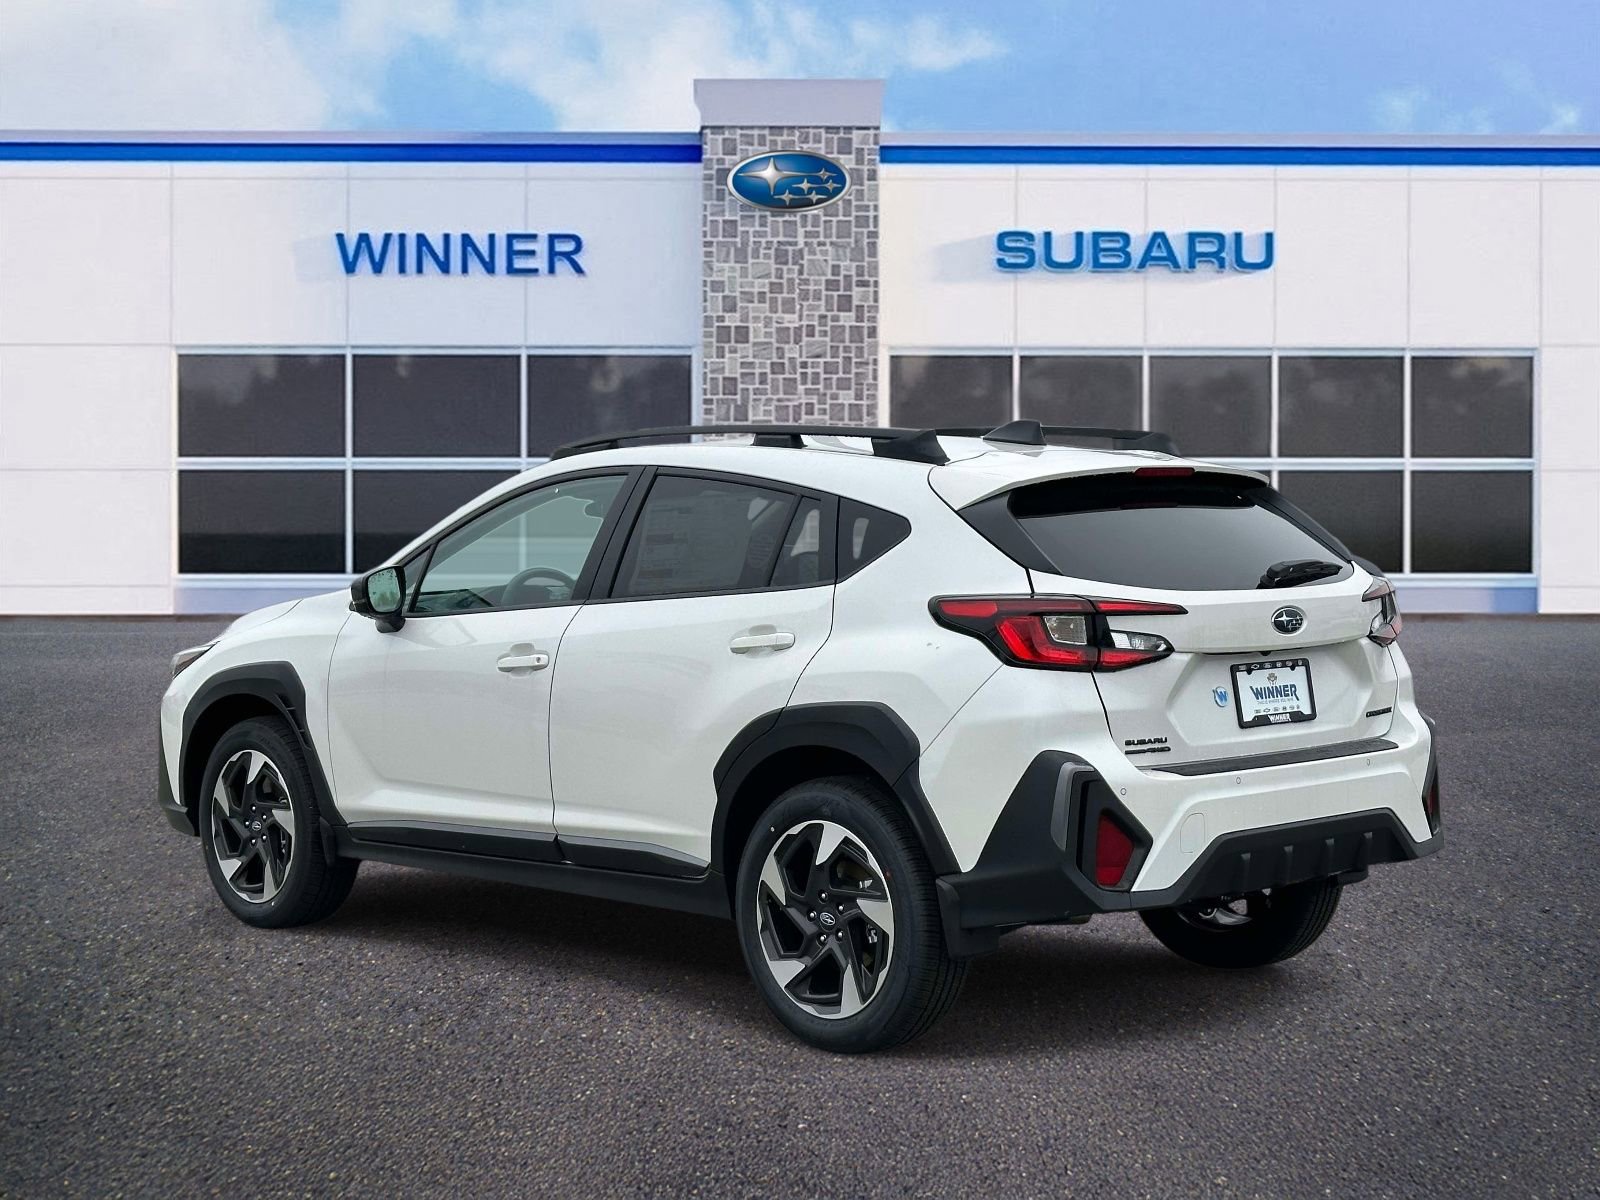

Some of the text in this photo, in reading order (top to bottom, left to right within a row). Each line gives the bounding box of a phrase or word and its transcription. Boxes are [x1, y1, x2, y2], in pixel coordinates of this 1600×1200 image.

[335, 232, 585, 276] WINNER
[995, 230, 1275, 271] SUBARU
[1249, 683, 1300, 701] WINNER
[1267, 713, 1292, 723] WINNER
[1124, 736, 1168, 746] SUBARU
